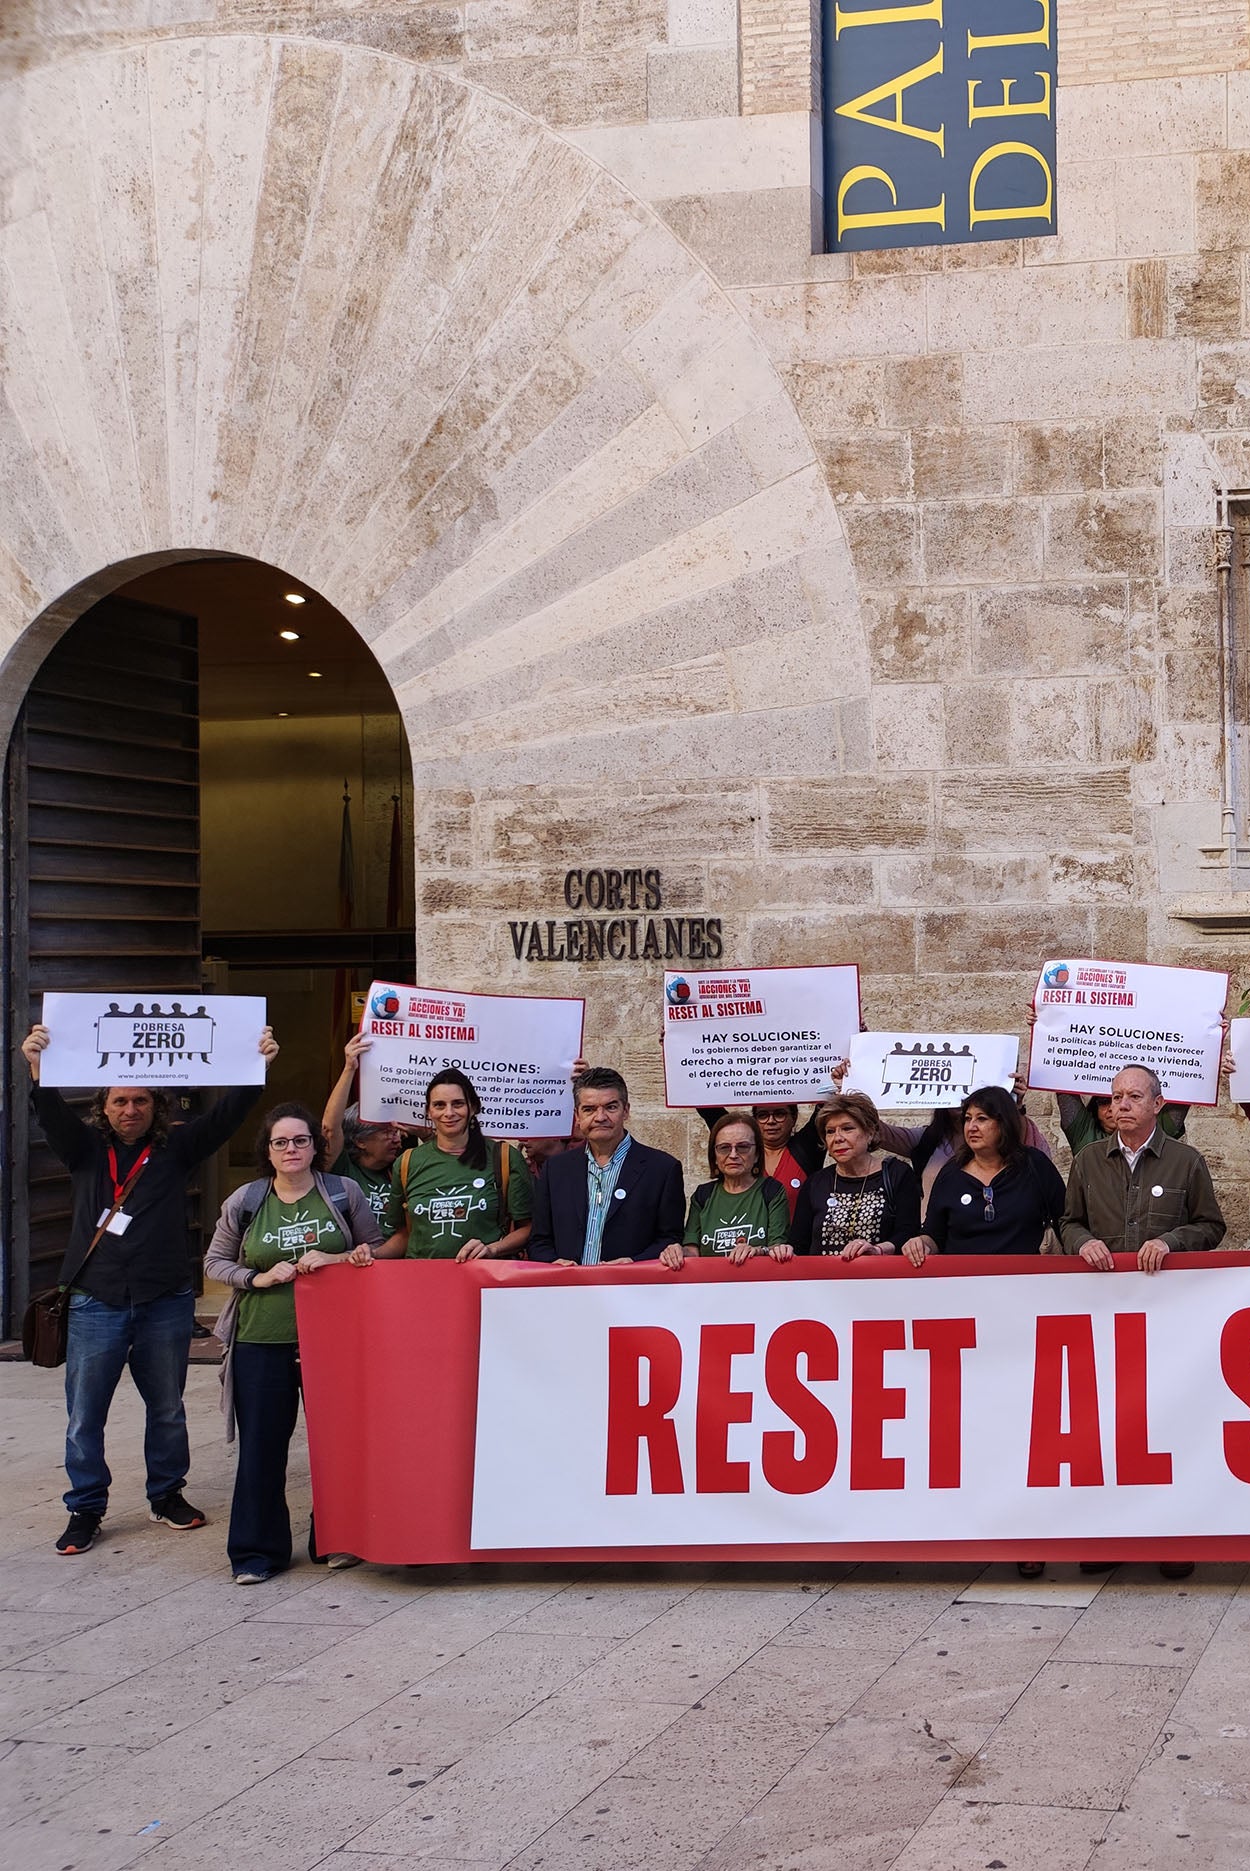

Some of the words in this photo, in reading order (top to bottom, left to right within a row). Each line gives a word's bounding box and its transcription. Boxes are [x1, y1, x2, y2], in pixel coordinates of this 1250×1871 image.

[563, 868, 663, 910] CORTS
[508, 917, 723, 961] VALENCIANES
[739, 983, 751, 993] YA!
[1043, 990, 1072, 1003] RESET
[1075, 991, 1087, 1004] AL
[1090, 992, 1134, 1006] SISTEMA
[453, 1006, 466, 1018] YA!
[668, 1006, 698, 1020] RESET
[702, 1005, 714, 1017] AL
[717, 1001, 763, 1016] SISTEMA
[133, 1022, 185, 1032] POBRESA
[371, 1021, 405, 1036] RESET
[408, 1023, 420, 1038] AL
[425, 1024, 475, 1041] SISTEMA
[702, 1034, 728, 1043] HAY
[732, 1031, 820, 1043] SOLUCIONES:
[1070, 1024, 1095, 1034] HAY
[1099, 1026, 1184, 1043] SOLUCIONES:
[132, 1033, 185, 1049] ZERO
[1061, 1037, 1097, 1046] políticas
[1099, 1040, 1134, 1049] públicas
[1136, 1043, 1162, 1052] deben
[1165, 1045, 1205, 1055] favorecer
[707, 1046, 749, 1054] gobiernos
[780, 1044, 821, 1052] garantizar
[409, 1054, 437, 1066] HAY
[442, 1058, 540, 1074] SOLUCIONES:
[680, 1057, 724, 1066] derecho
[737, 1056, 771, 1065] migrar
[912, 1059, 952, 1067] POBRESA
[1053, 1057, 1096, 1069] igualdad
[1057, 1048, 1097, 1059] empleo,
[1109, 1053, 1138, 1061] acceso
[1158, 1056, 1203, 1068] vivienda,
[380, 1065, 393, 1073] los
[396, 1068, 438, 1077] gobierno
[700, 1069, 743, 1078] derecho
[746, 1068, 759, 1076] de
[762, 1067, 800, 1076] refugio
[803, 1068, 809, 1076] y
[910, 1067, 952, 1082] ZERO
[1169, 1071, 1205, 1080] mujeres,
[380, 1076, 431, 1087] comerciale
[477, 1076, 514, 1084] cambiar
[517, 1077, 530, 1085] las
[489, 1085, 501, 1093] de
[504, 1087, 556, 1095] producción
[734, 1089, 795, 1097] internamiento.
[481, 1106, 531, 1116] tenibles
[534, 1109, 562, 1117] para
[480, 1121, 529, 1130] ersonas.
[432, 1200, 465, 1209] POBRESA
[432, 1207, 465, 1220] ZERO
[282, 1232, 316, 1247] ZERO
[606, 1317, 977, 1496] RESET
[1026, 1312, 1173, 1488] AL
